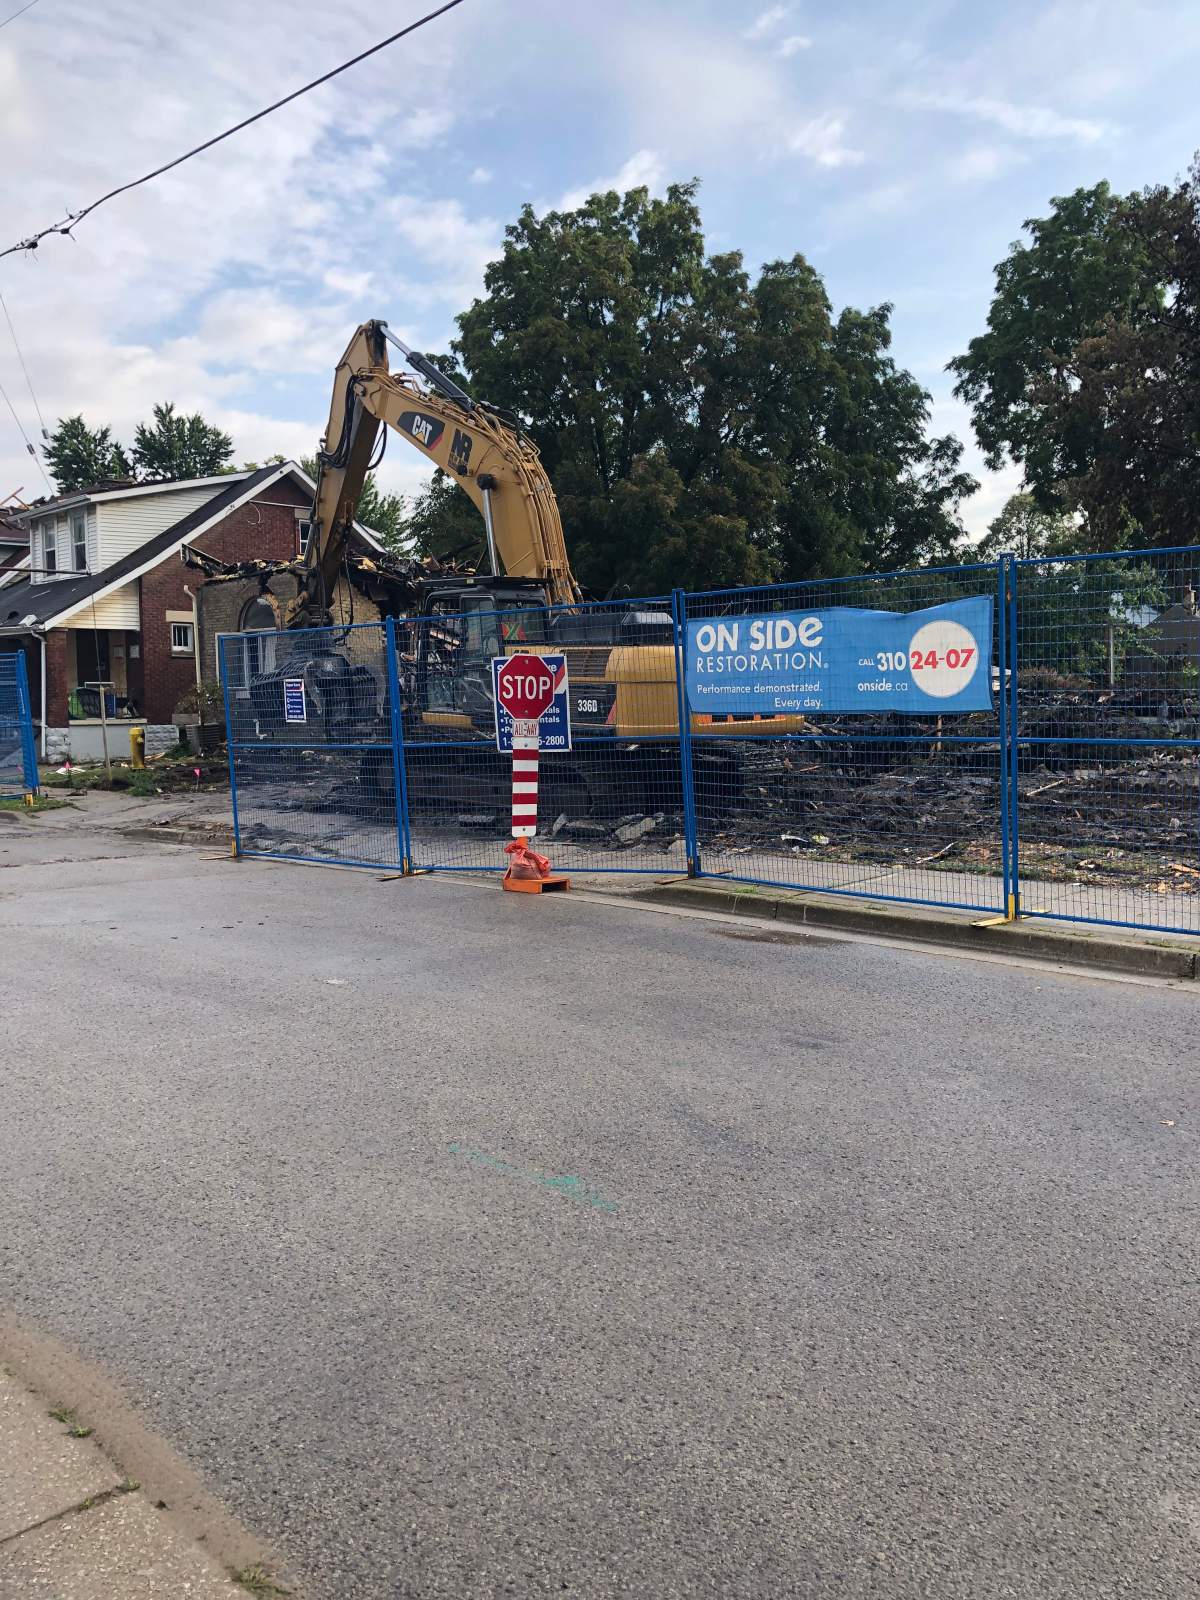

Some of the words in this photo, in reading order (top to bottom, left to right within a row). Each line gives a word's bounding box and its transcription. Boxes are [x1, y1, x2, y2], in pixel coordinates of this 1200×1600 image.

[412, 415, 432, 445] CAT
[696, 623, 739, 653] ON
[858, 658, 874, 666] CALL
[876, 651, 907, 672] 310
[910, 648, 975, 670] 24-07
[502, 675, 551, 700] STOP
[697, 684, 751, 694] Performance
[753, 681, 823, 693] demonstrated.
[857, 677, 908, 691] onside.ca
[577, 700, 598, 713] 336D
[774, 698, 801, 710] Every
[803, 697, 823, 709] day.
